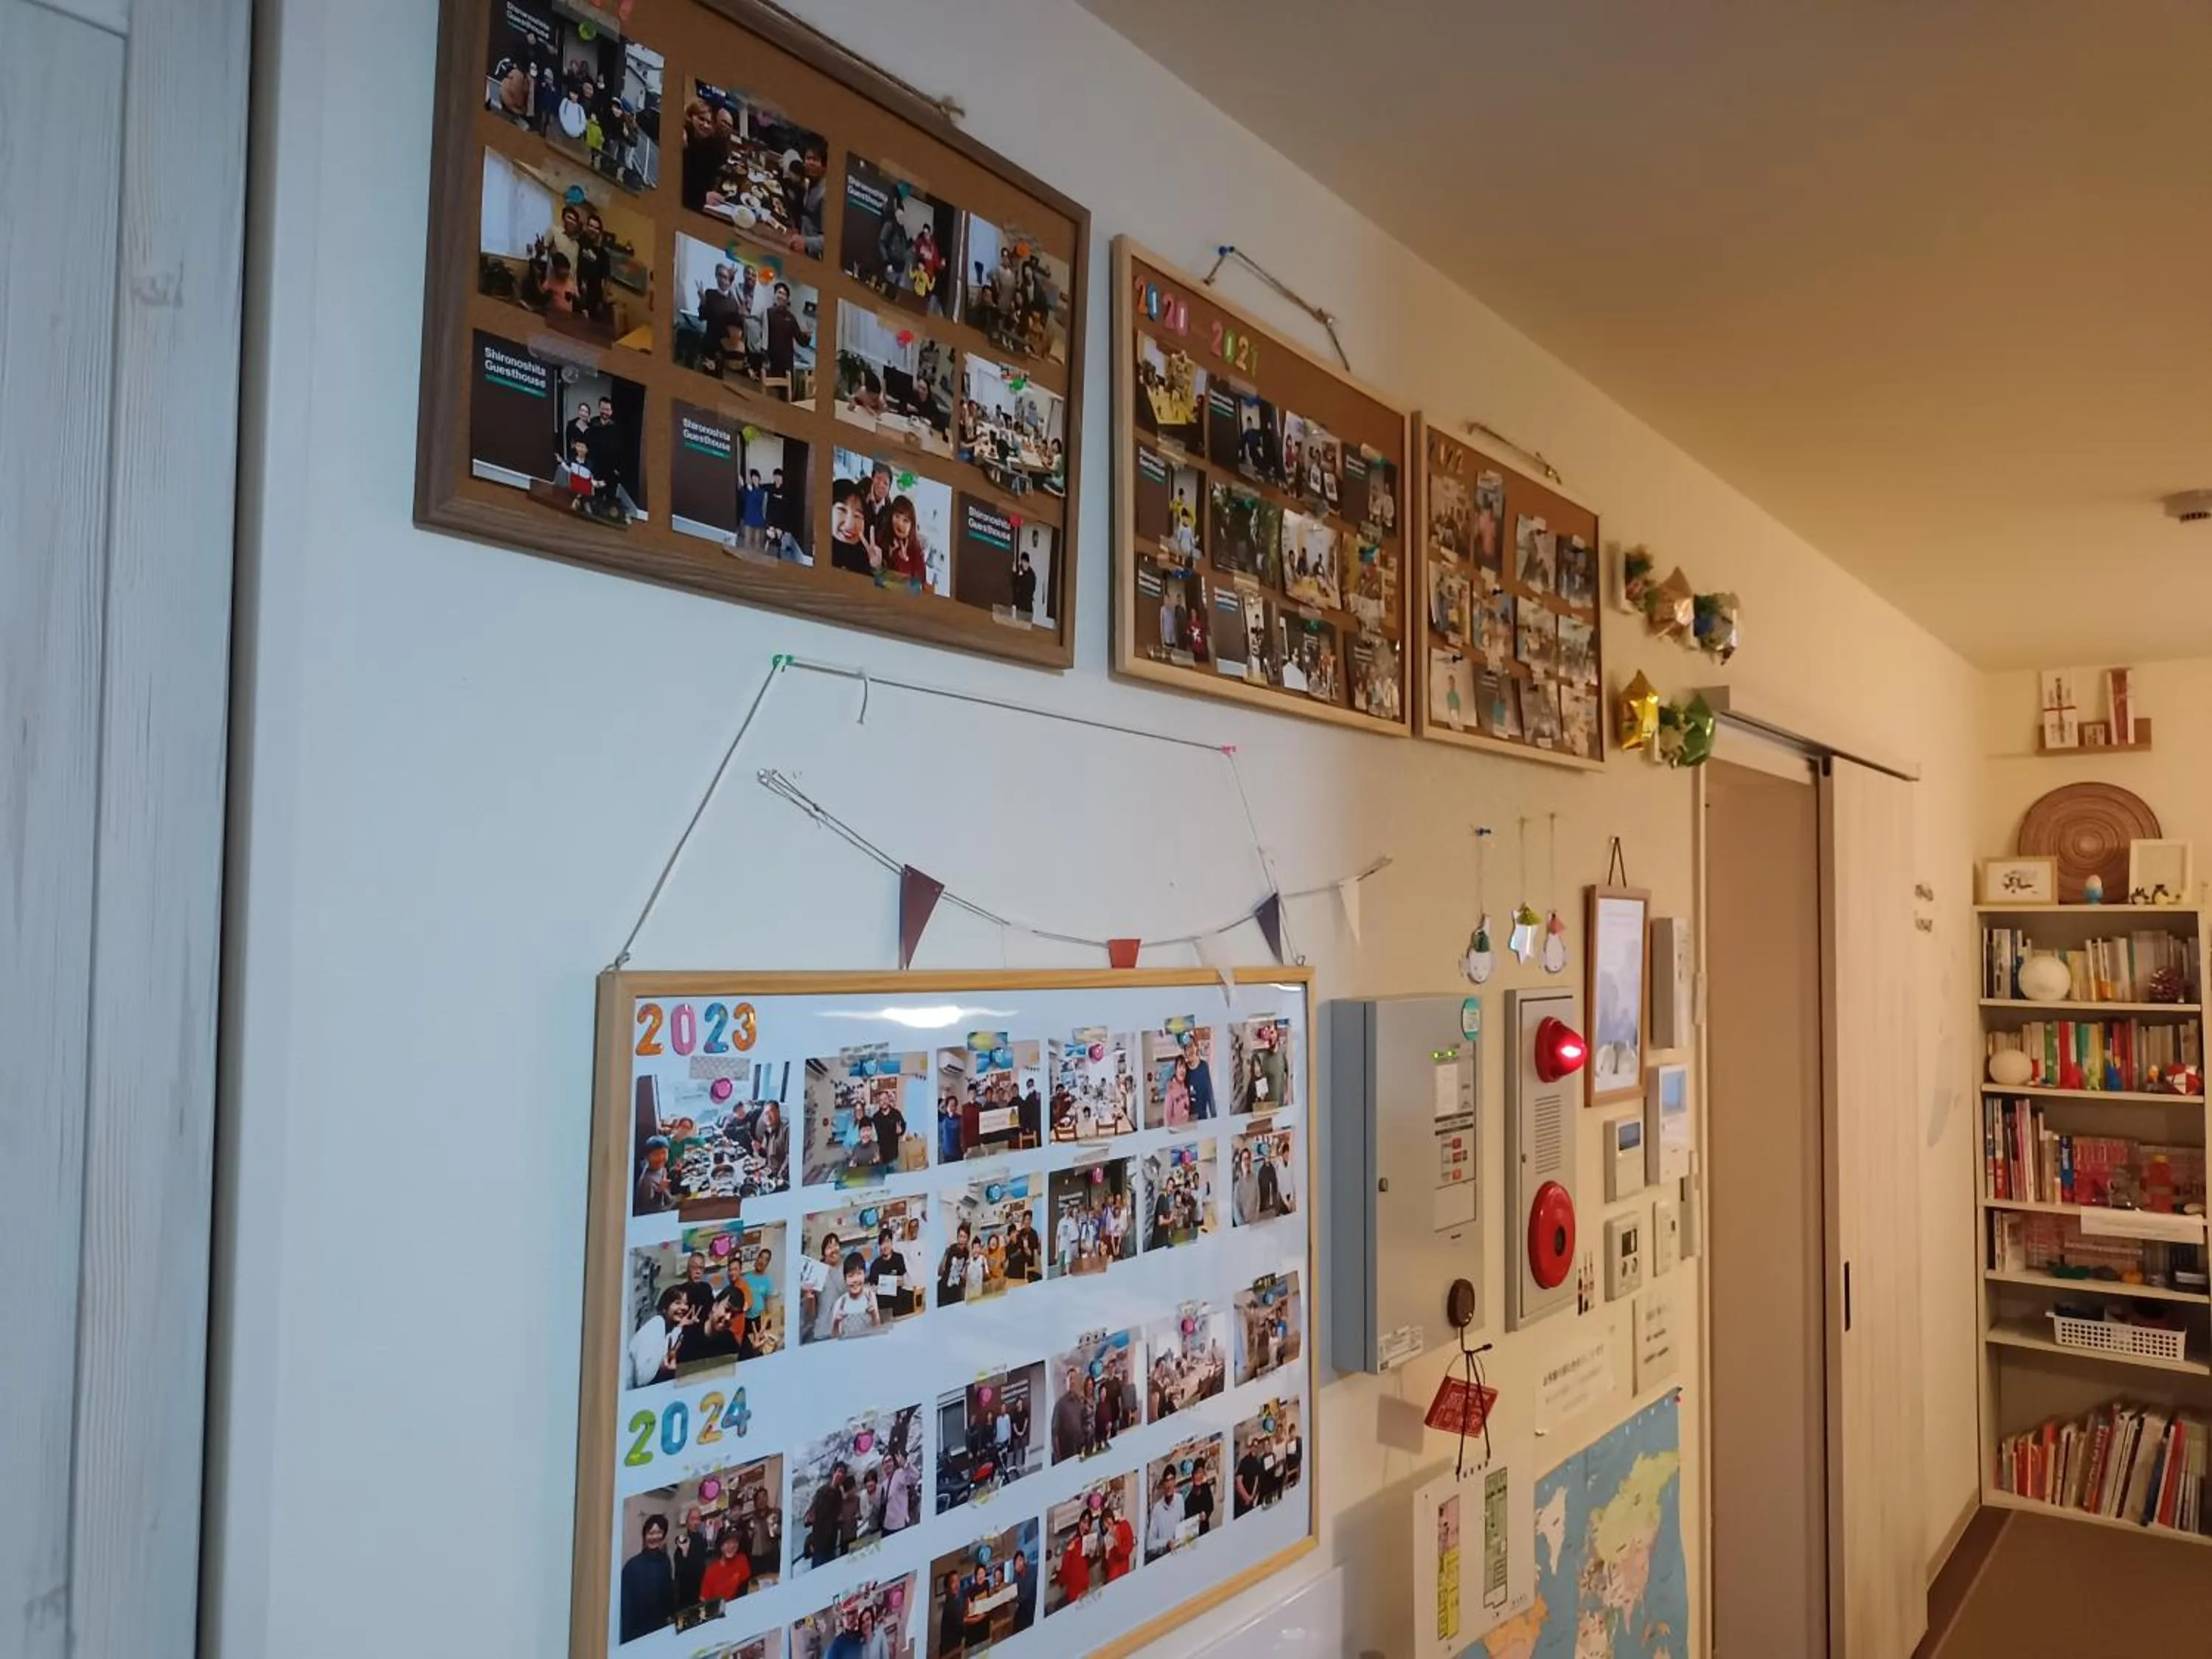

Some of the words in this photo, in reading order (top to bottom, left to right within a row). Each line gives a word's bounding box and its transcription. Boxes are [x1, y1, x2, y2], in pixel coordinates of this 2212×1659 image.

[484, 347, 546, 377] Shironoshita
[484, 359, 546, 389] Guesthouse
[636, 1002, 757, 1057] 2023
[624, 1386, 752, 1467] 2024
